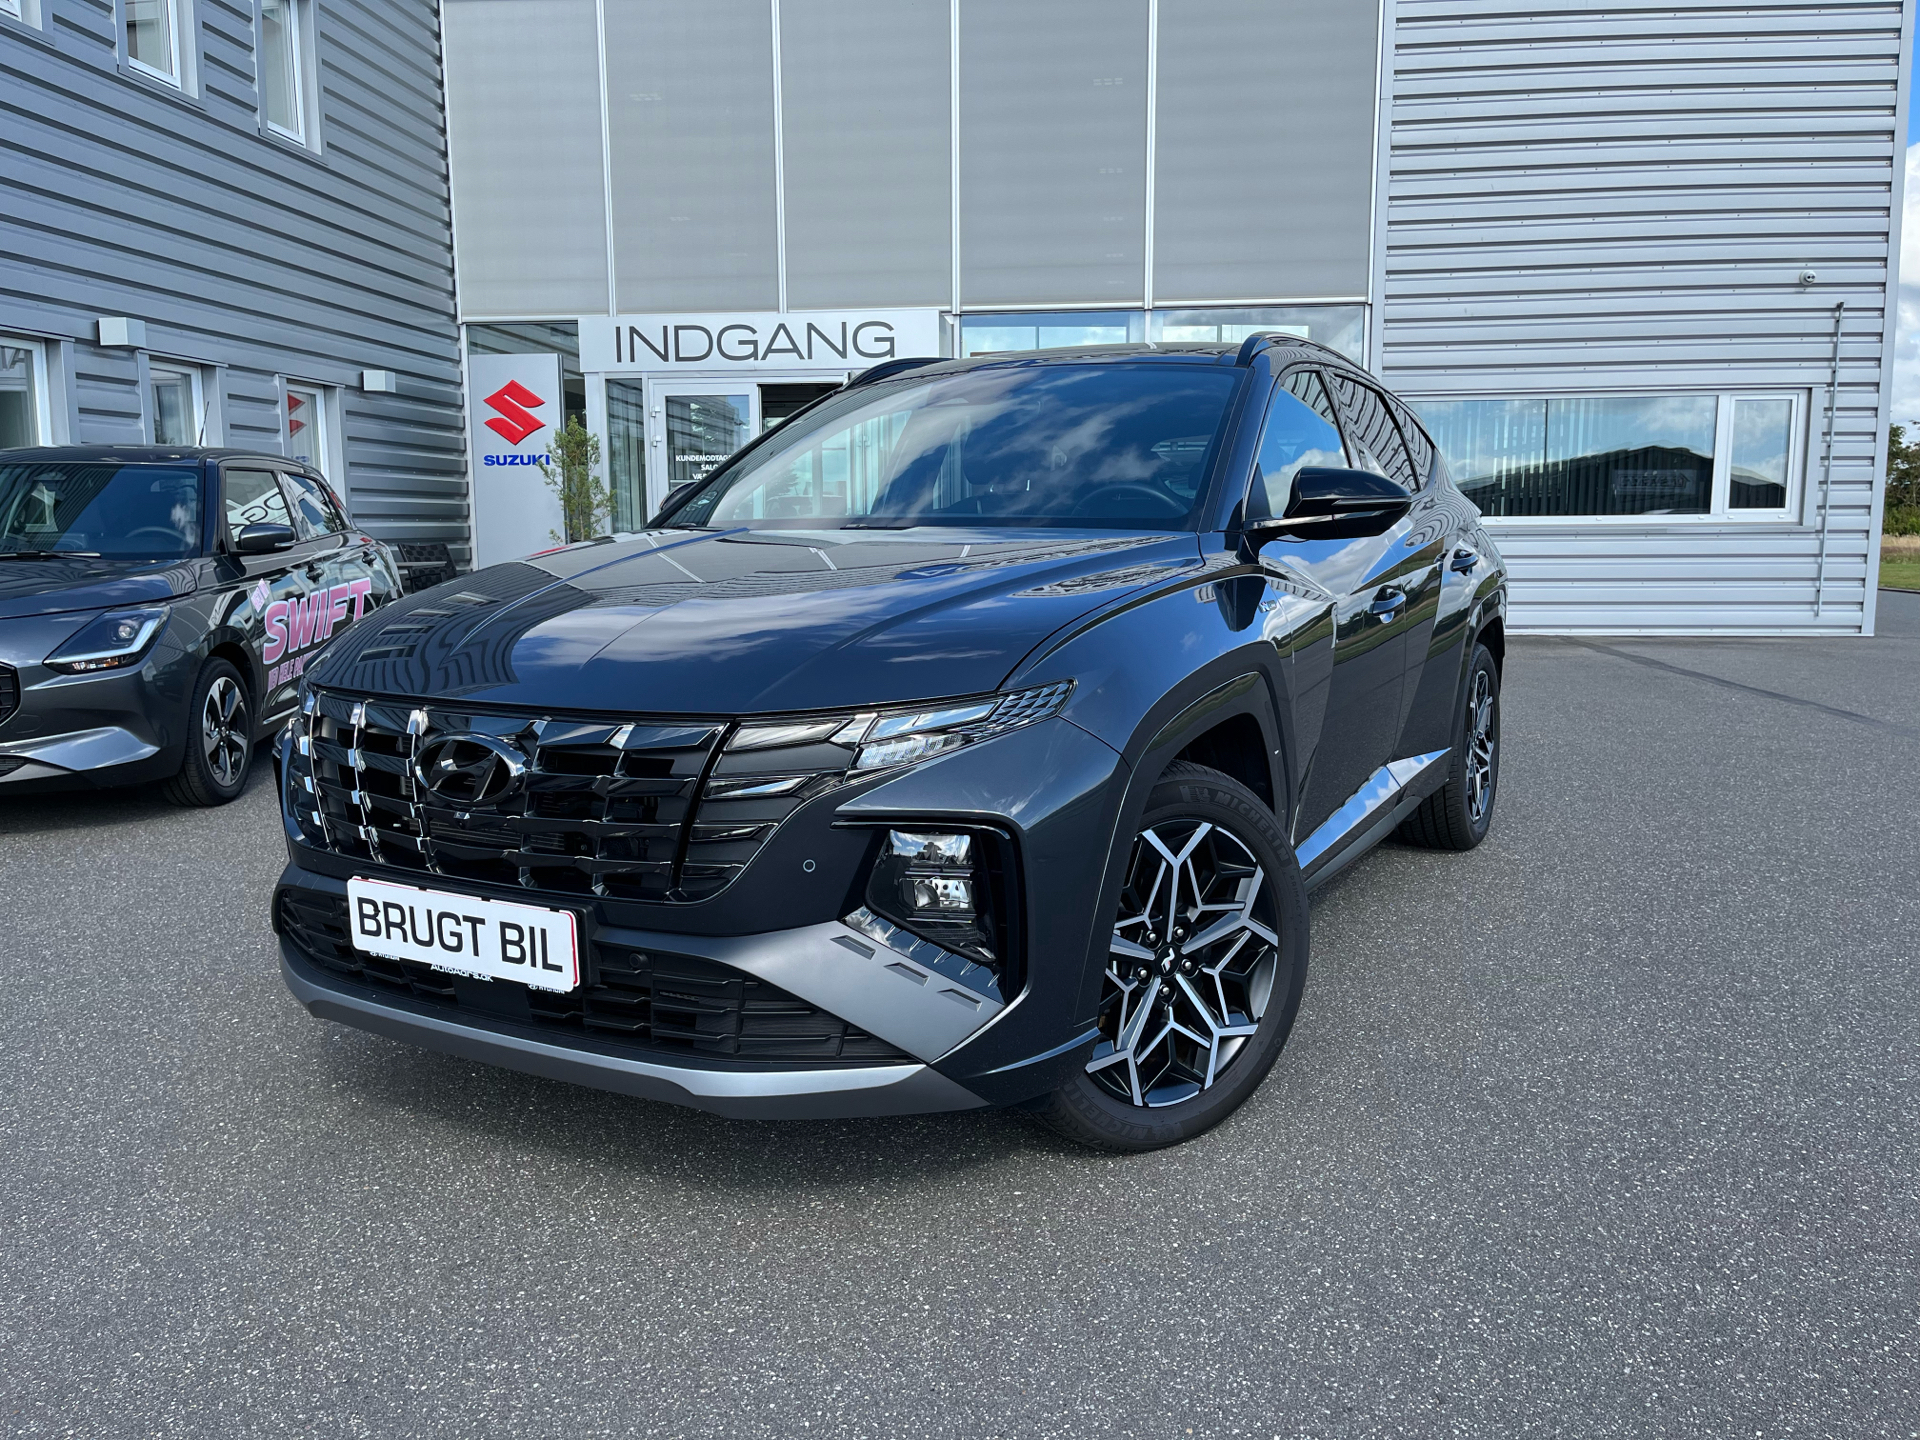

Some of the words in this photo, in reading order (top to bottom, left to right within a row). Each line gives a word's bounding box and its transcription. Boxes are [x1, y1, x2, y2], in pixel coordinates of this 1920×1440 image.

[615, 321, 895, 363] INDGANG
[483, 454, 551, 467] SUZUKI
[263, 577, 372, 665] SWIFT
[1213, 790, 1289, 862] MICHELIN
[1288, 875, 1303, 918] PRIMACY
[356, 896, 486, 957] BRUGT
[499, 920, 564, 973] BIL
